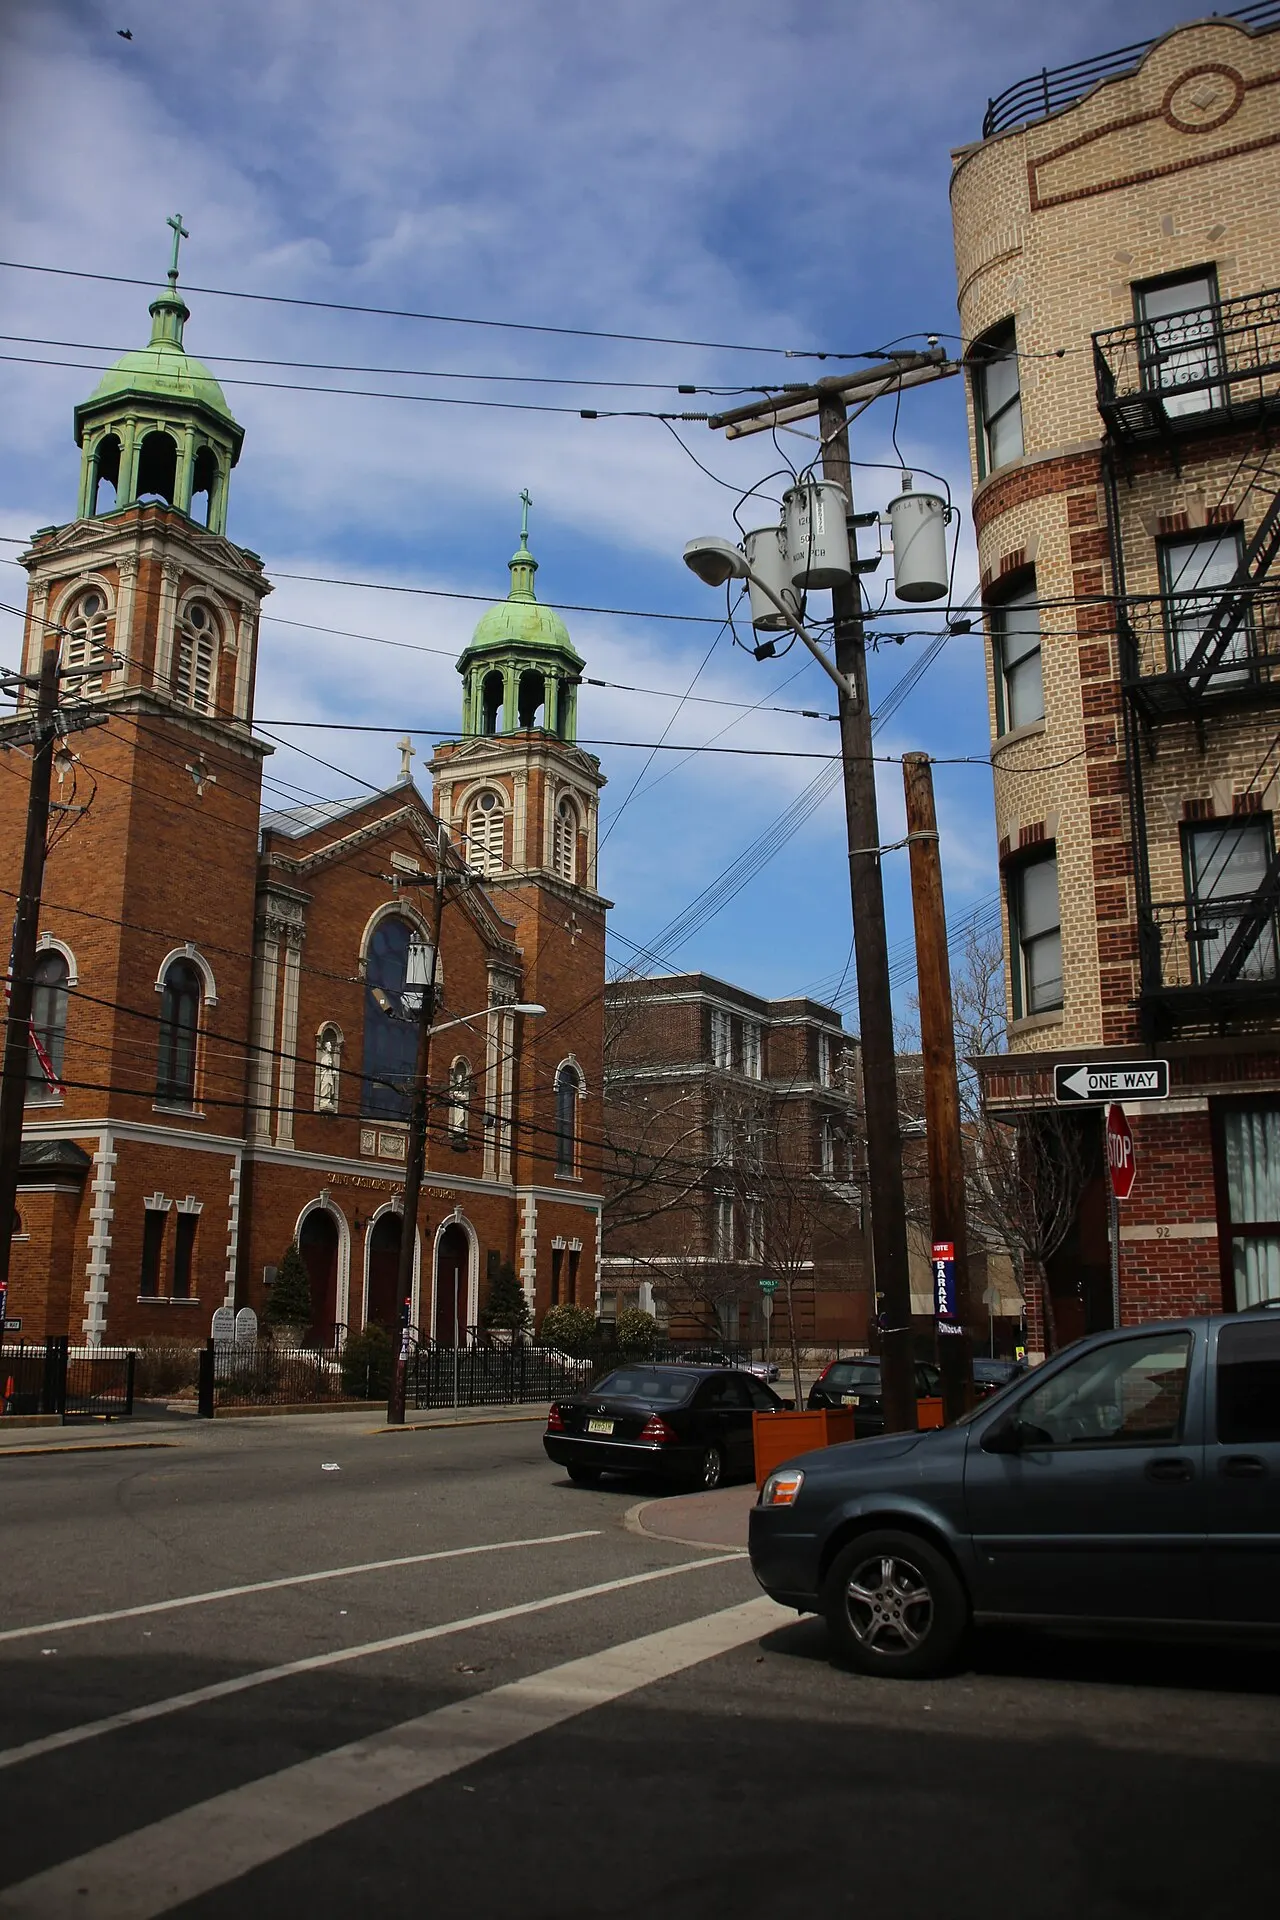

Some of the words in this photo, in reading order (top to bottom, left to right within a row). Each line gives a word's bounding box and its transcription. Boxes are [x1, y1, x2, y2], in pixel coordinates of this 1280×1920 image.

[1088, 1074, 1118, 1089] ONE
[1124, 1073, 1155, 1088] WAY
[1108, 1133, 1131, 1168] STOP
[1156, 1227, 1171, 1238] 92
[936, 1260, 948, 1313] BARAKA
